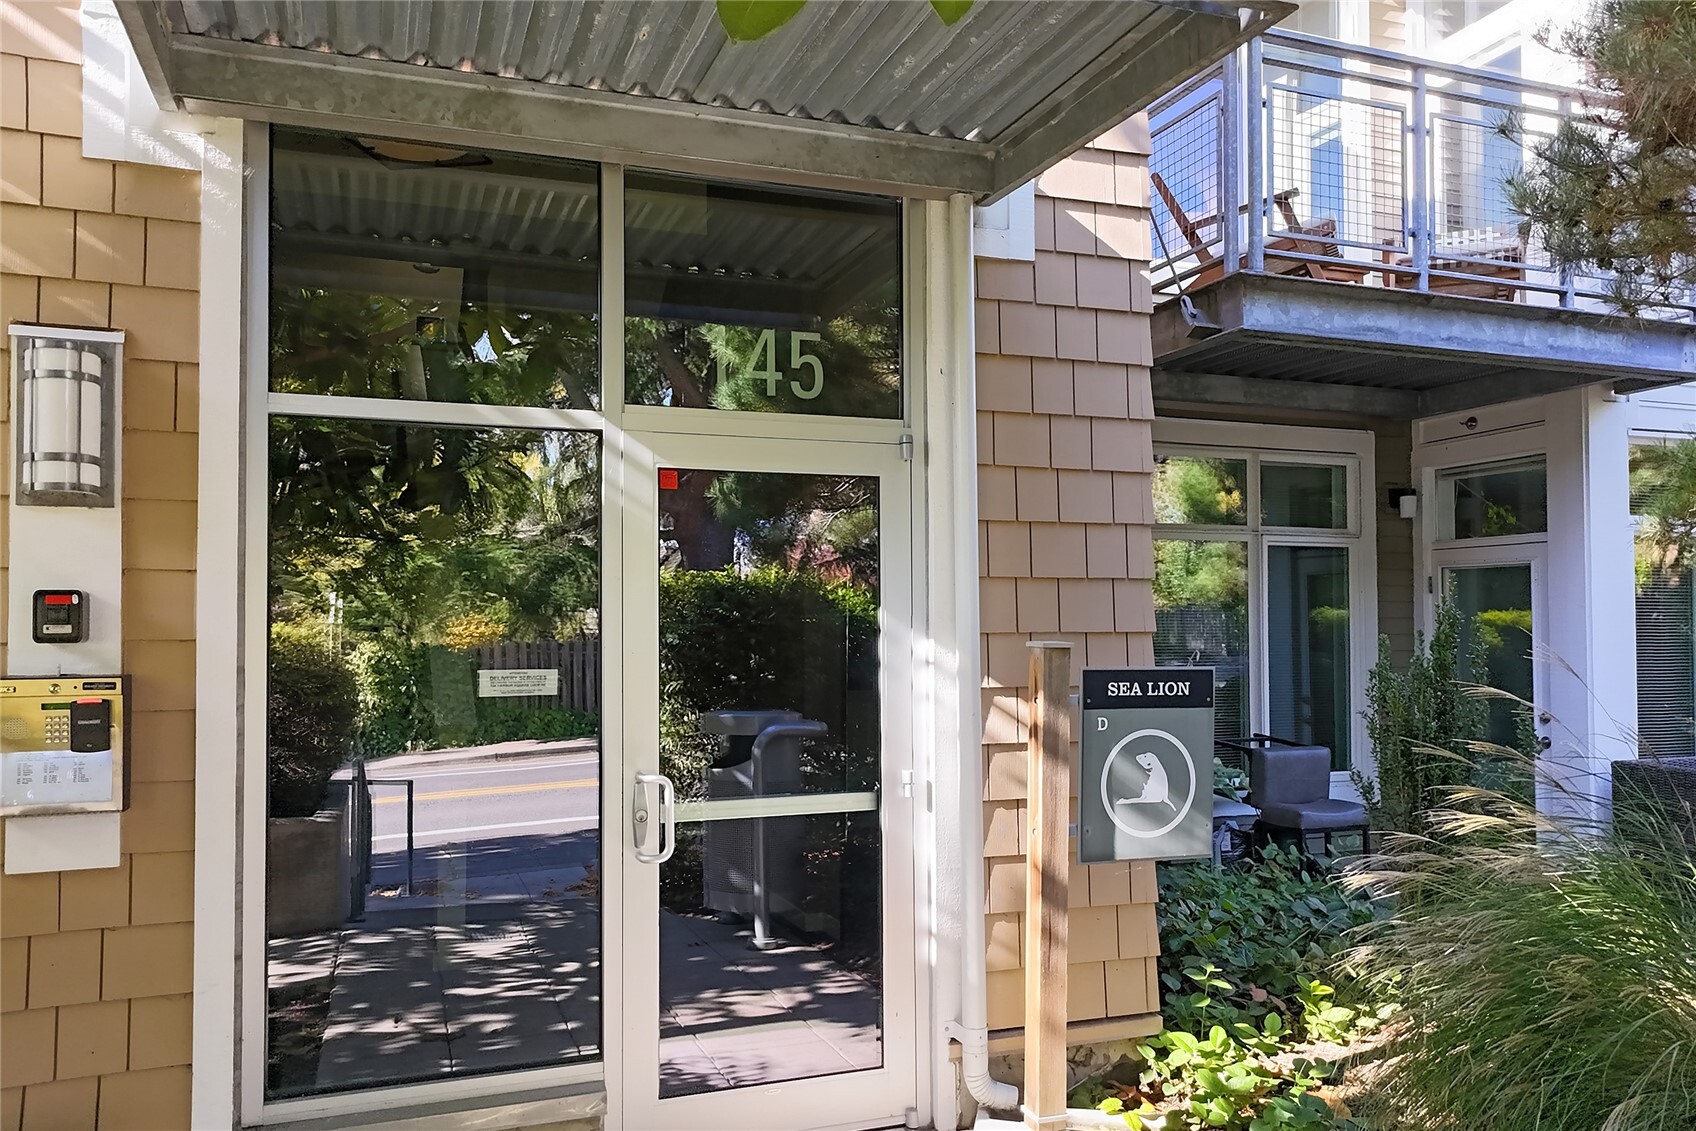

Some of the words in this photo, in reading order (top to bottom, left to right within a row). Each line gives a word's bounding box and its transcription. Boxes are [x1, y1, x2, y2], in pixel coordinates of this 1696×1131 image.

[1107, 682, 1143, 697] SEA
[1146, 682, 1191, 696] LION
[1097, 717, 1109, 731] D
